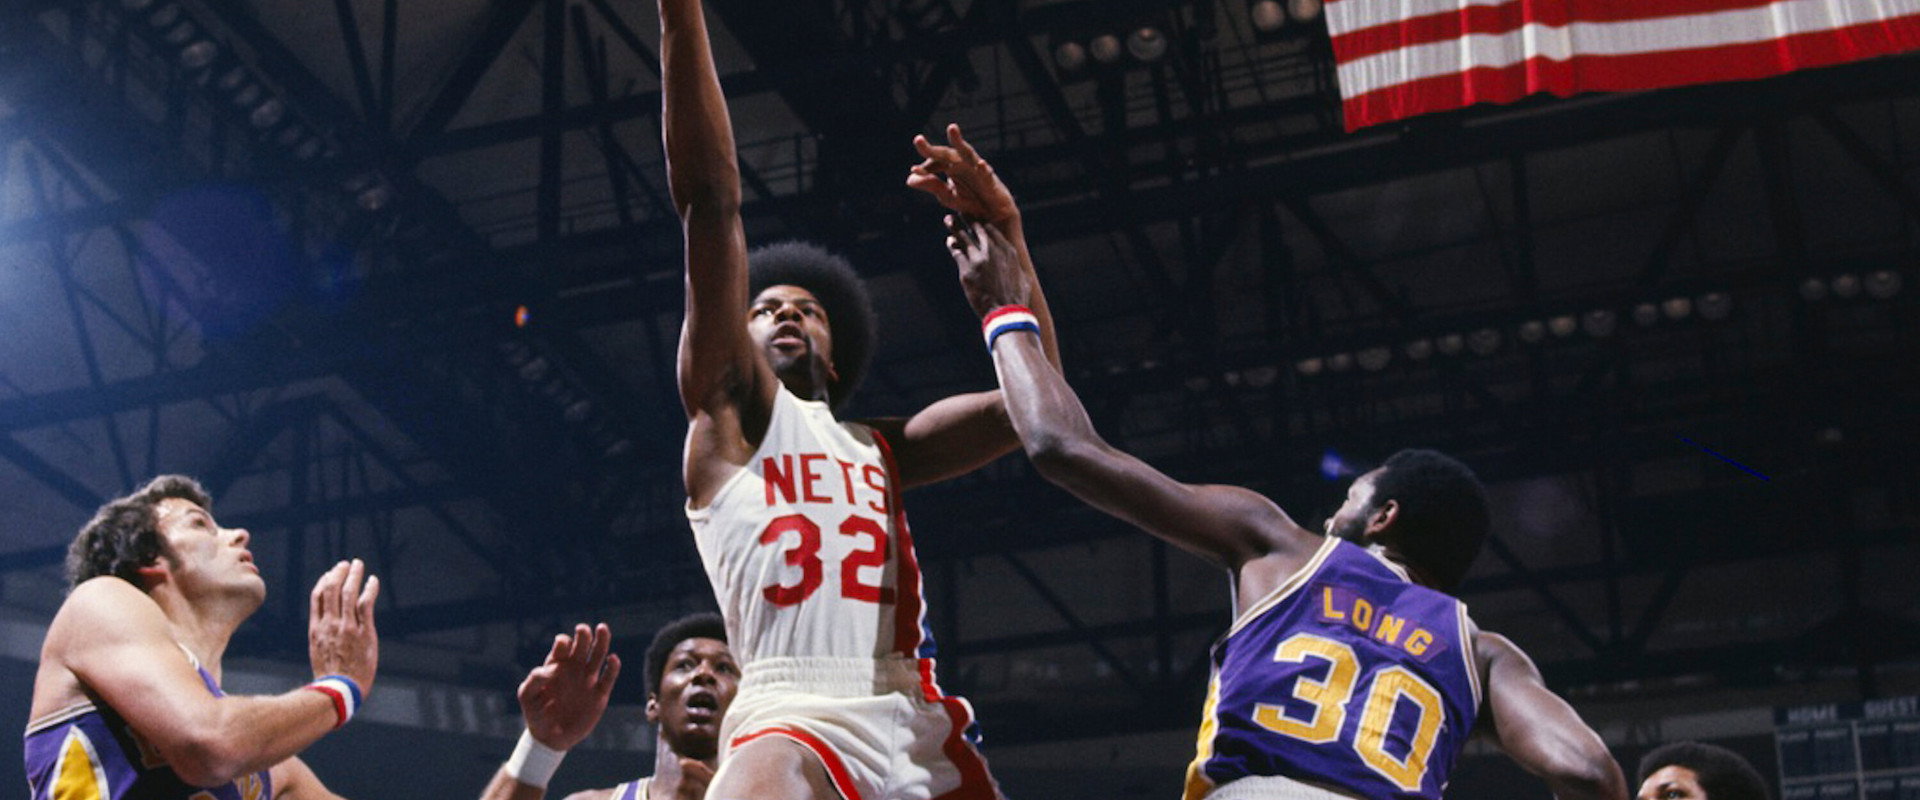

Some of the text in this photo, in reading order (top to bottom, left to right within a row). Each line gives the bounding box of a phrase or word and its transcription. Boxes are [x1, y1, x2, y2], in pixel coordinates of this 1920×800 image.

[763, 453, 888, 514] NETS
[759, 513, 896, 610] 32
[1322, 586, 1433, 656] LONG
[1251, 632, 1446, 792] 30
